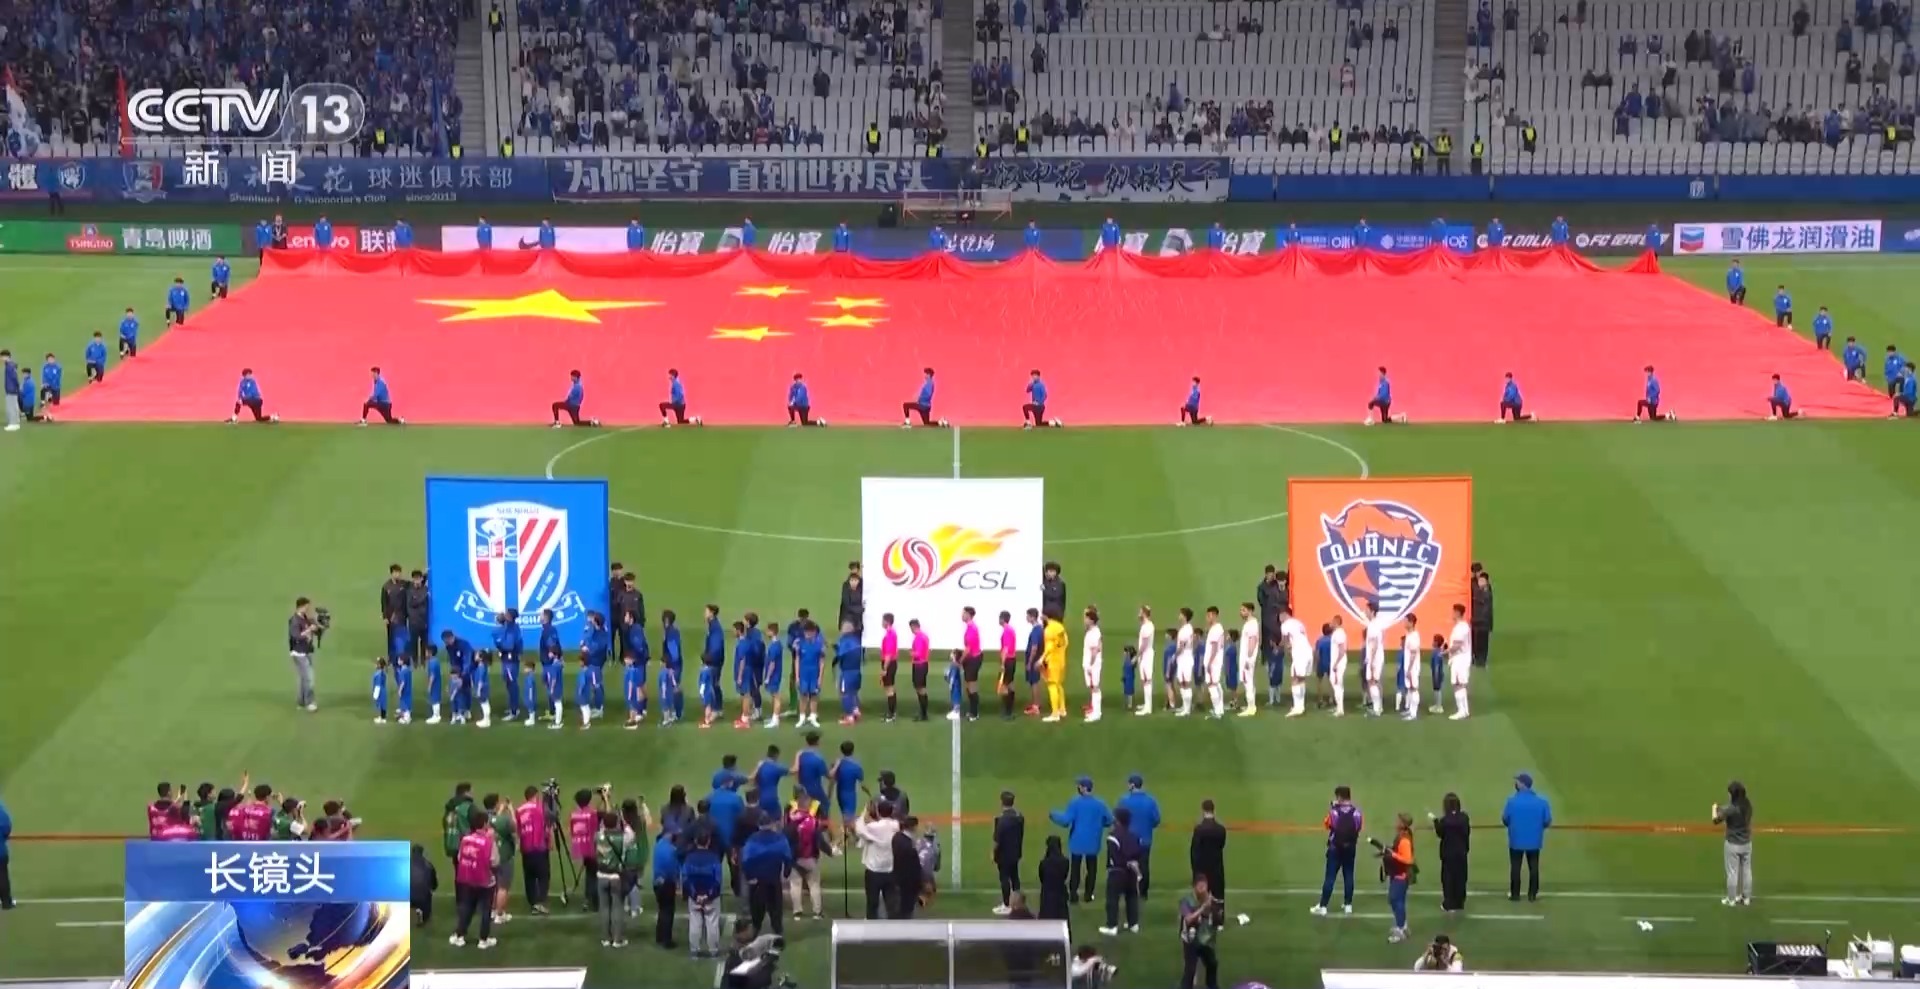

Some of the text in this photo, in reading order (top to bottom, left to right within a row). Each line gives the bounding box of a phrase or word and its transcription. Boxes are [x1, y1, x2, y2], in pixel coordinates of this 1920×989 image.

[368, 163, 513, 189] 球迷俱乐部
[565, 158, 932, 193] 为你坚守 直到世界尽头
[122, 228, 212, 250] 青岛啤酒
[1721, 226, 1874, 249] 雪佛龙润滑油
[477, 545, 518, 556] SFC
[957, 571, 1017, 590] CSL
